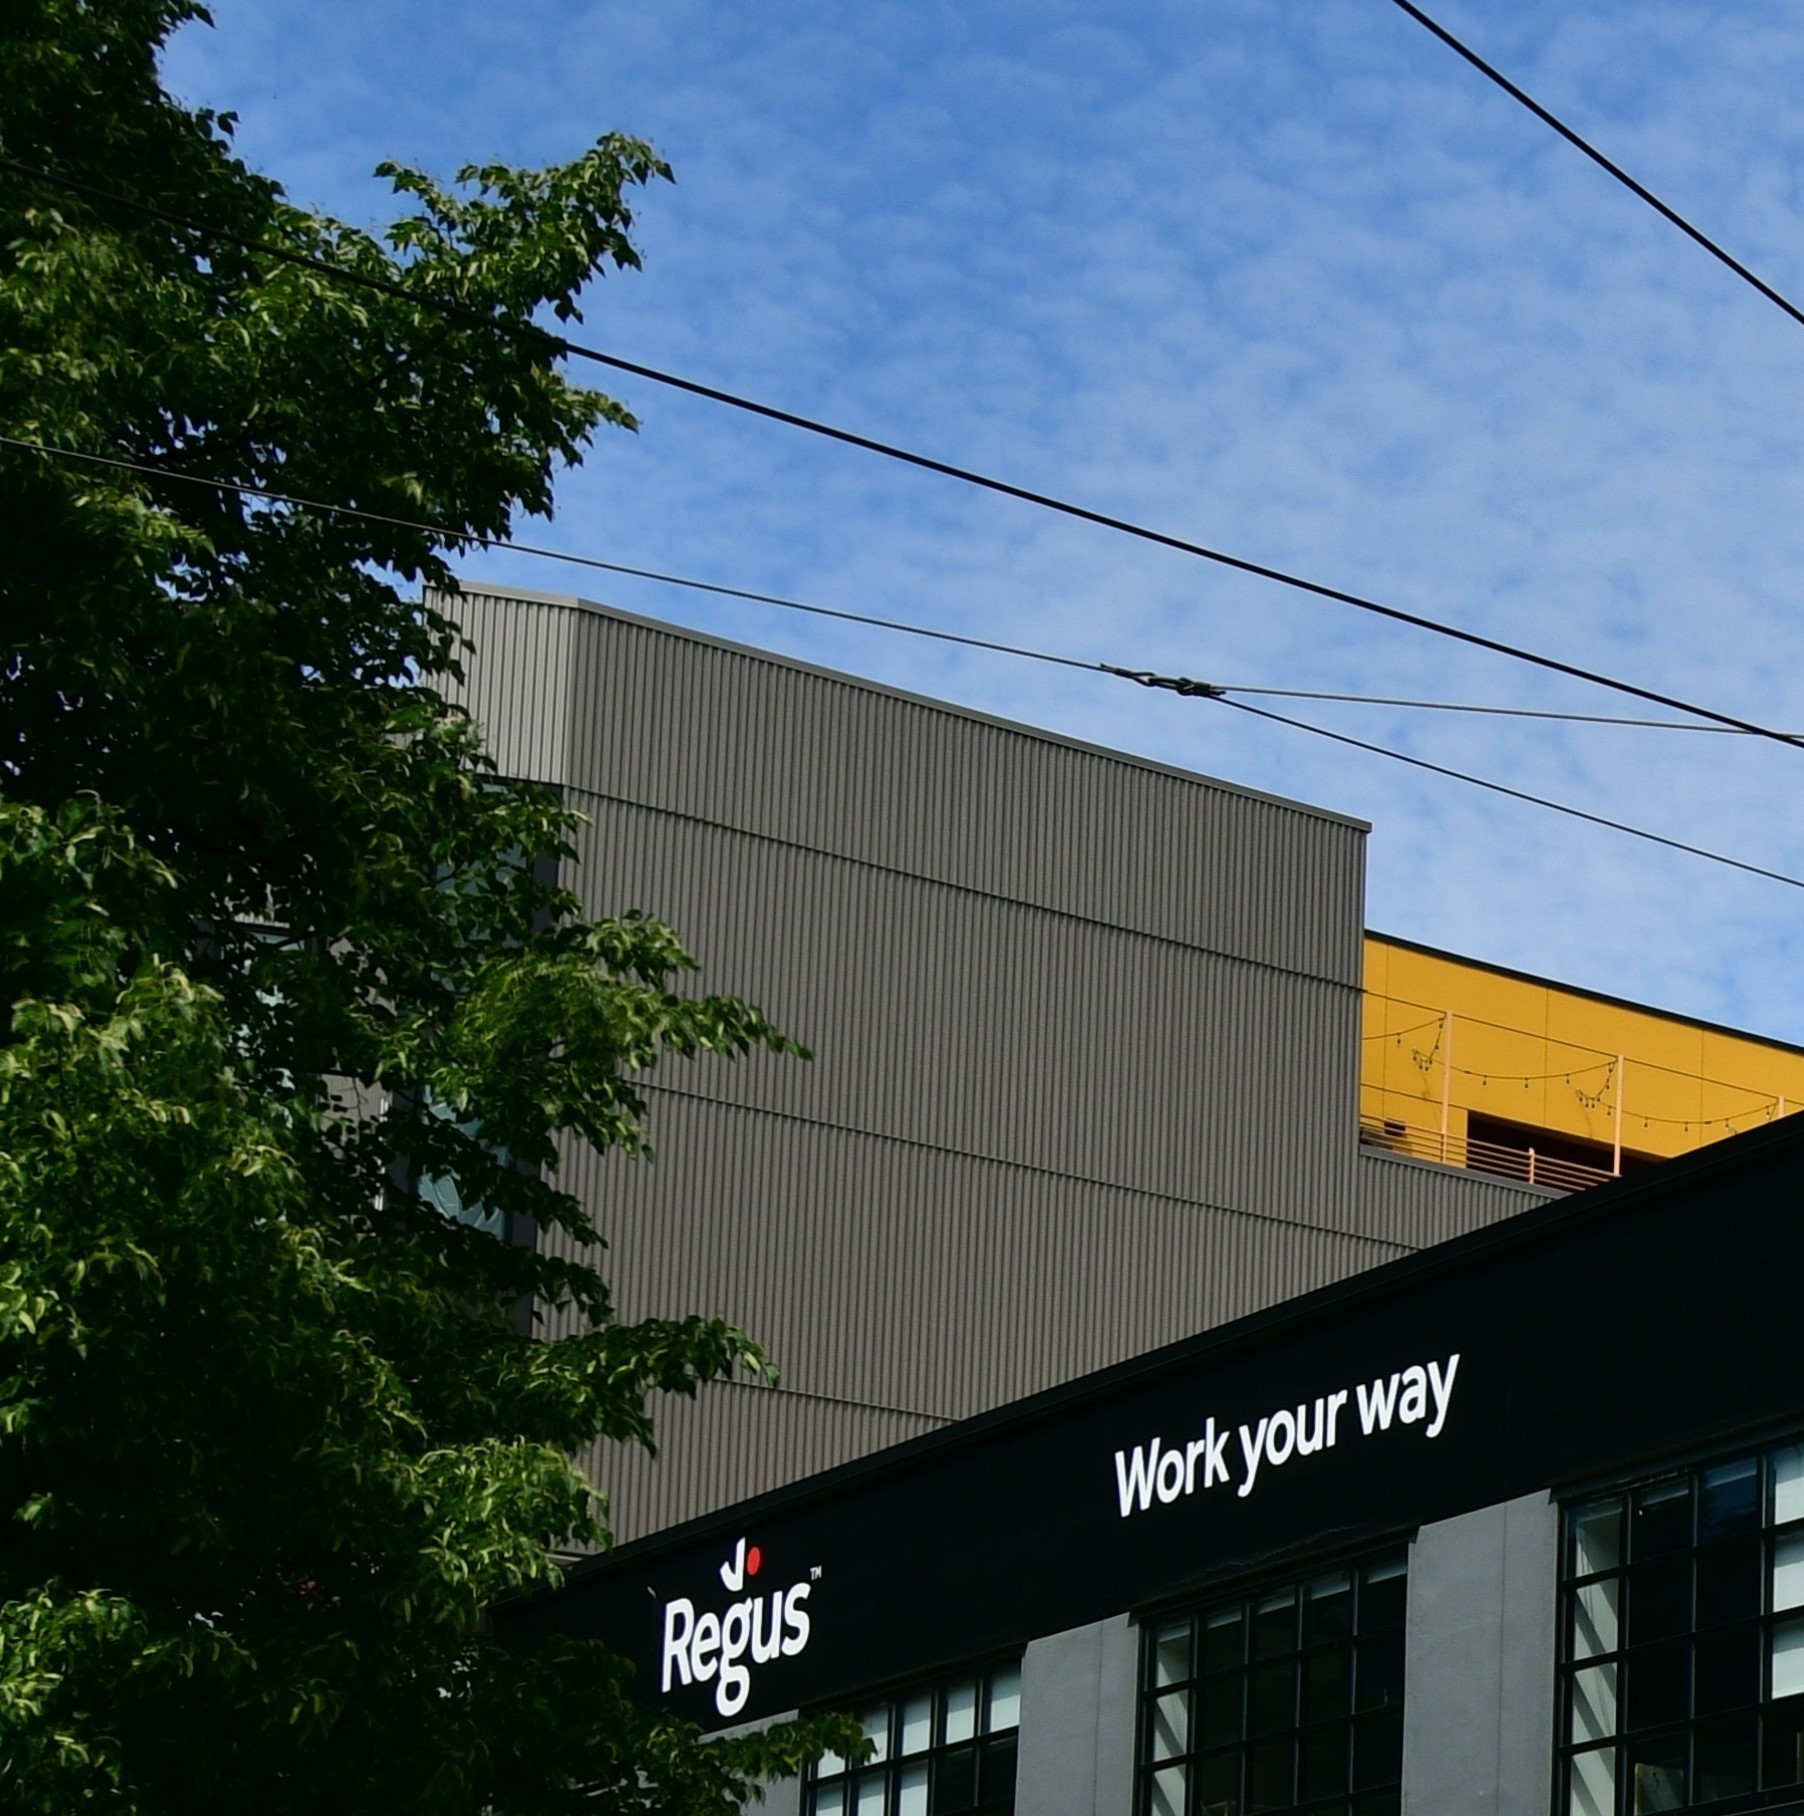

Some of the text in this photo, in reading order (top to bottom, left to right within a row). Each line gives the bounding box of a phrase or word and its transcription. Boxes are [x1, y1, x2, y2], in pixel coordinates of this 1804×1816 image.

[1114, 1353, 1461, 1518] Work your way
[661, 1582, 812, 1717] Regus
